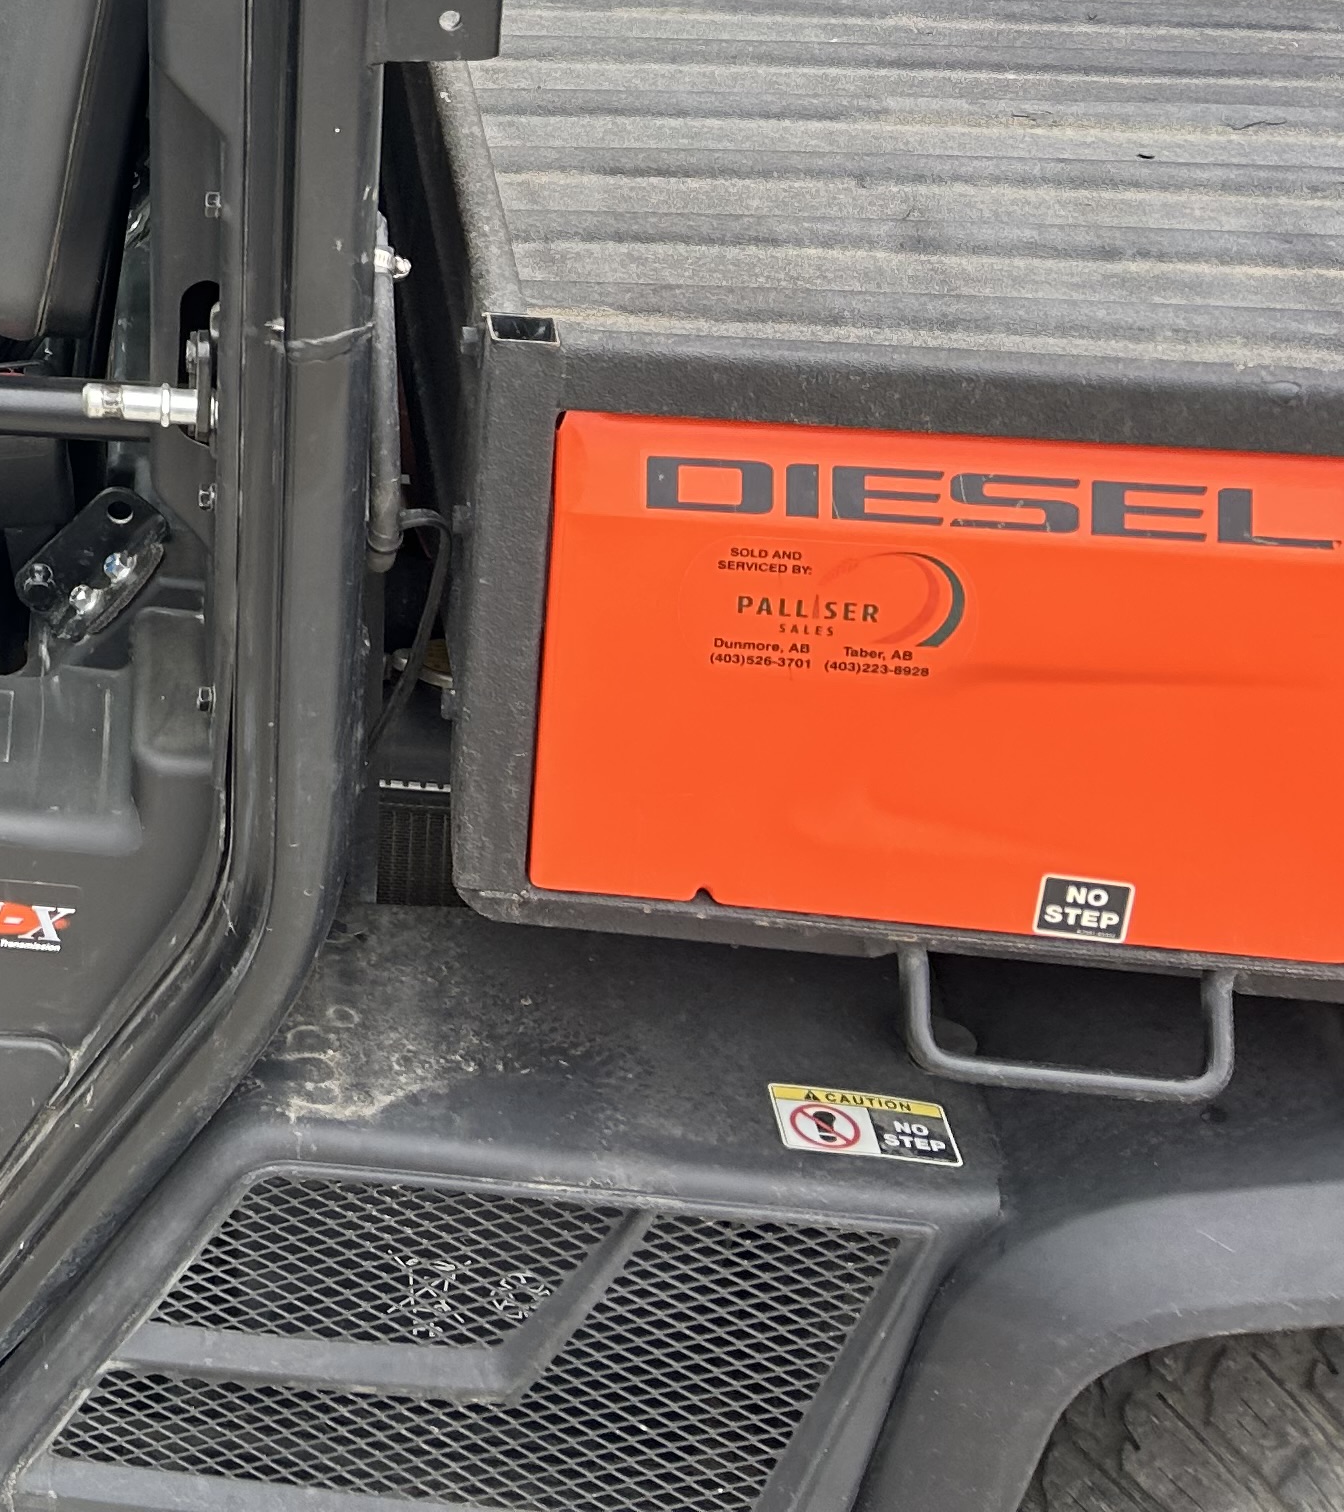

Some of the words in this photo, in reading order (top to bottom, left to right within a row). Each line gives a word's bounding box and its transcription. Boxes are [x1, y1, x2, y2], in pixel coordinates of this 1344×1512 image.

[646, 456, 1339, 550] DIESEL
[730, 547, 768, 559] SOLD
[772, 550, 802, 561] AND
[717, 560, 788, 573] SERVICED
[791, 565, 812, 575] BY:
[737, 594, 880, 623] PALLISER
[779, 623, 834, 637] SALES
[714, 638, 784, 654] Dunmore,
[788, 644, 810, 654] AB
[844, 646, 886, 661] Taber,
[890, 650, 913, 661] AB
[709, 652, 811, 670] (403)526-3701
[1066, 884, 1109, 907] NO
[1044, 904, 1120, 929] STEP
[825, 1093, 912, 1112] CAUTION
[893, 1120, 929, 1136] NO
[883, 1133, 946, 1152] STEP
